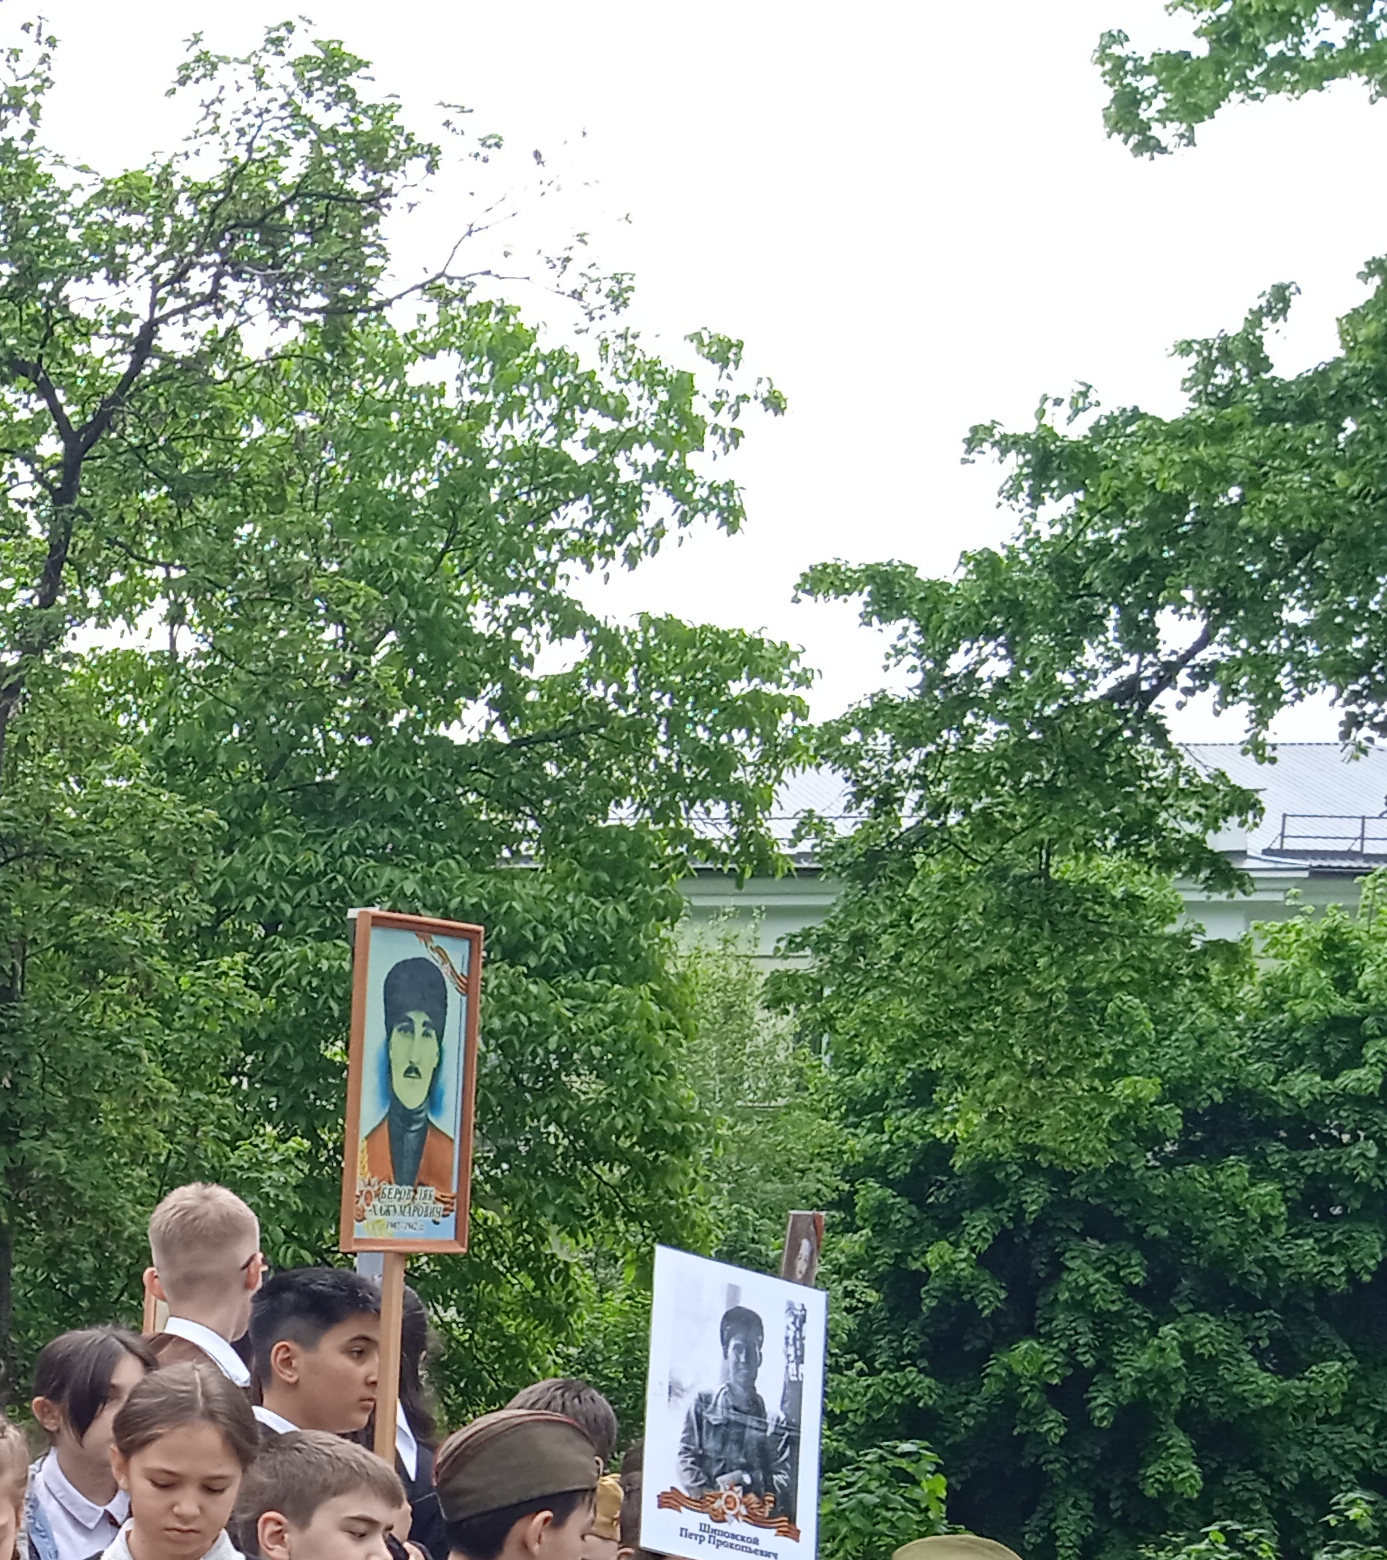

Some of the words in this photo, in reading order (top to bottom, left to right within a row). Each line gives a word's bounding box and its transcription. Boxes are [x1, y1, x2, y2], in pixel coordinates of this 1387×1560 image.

[679, 1527, 706, 1545] Петр
[707, 1535, 778, 1560] Прокопьевич
[699, 1522, 760, 1546] Шиповской
